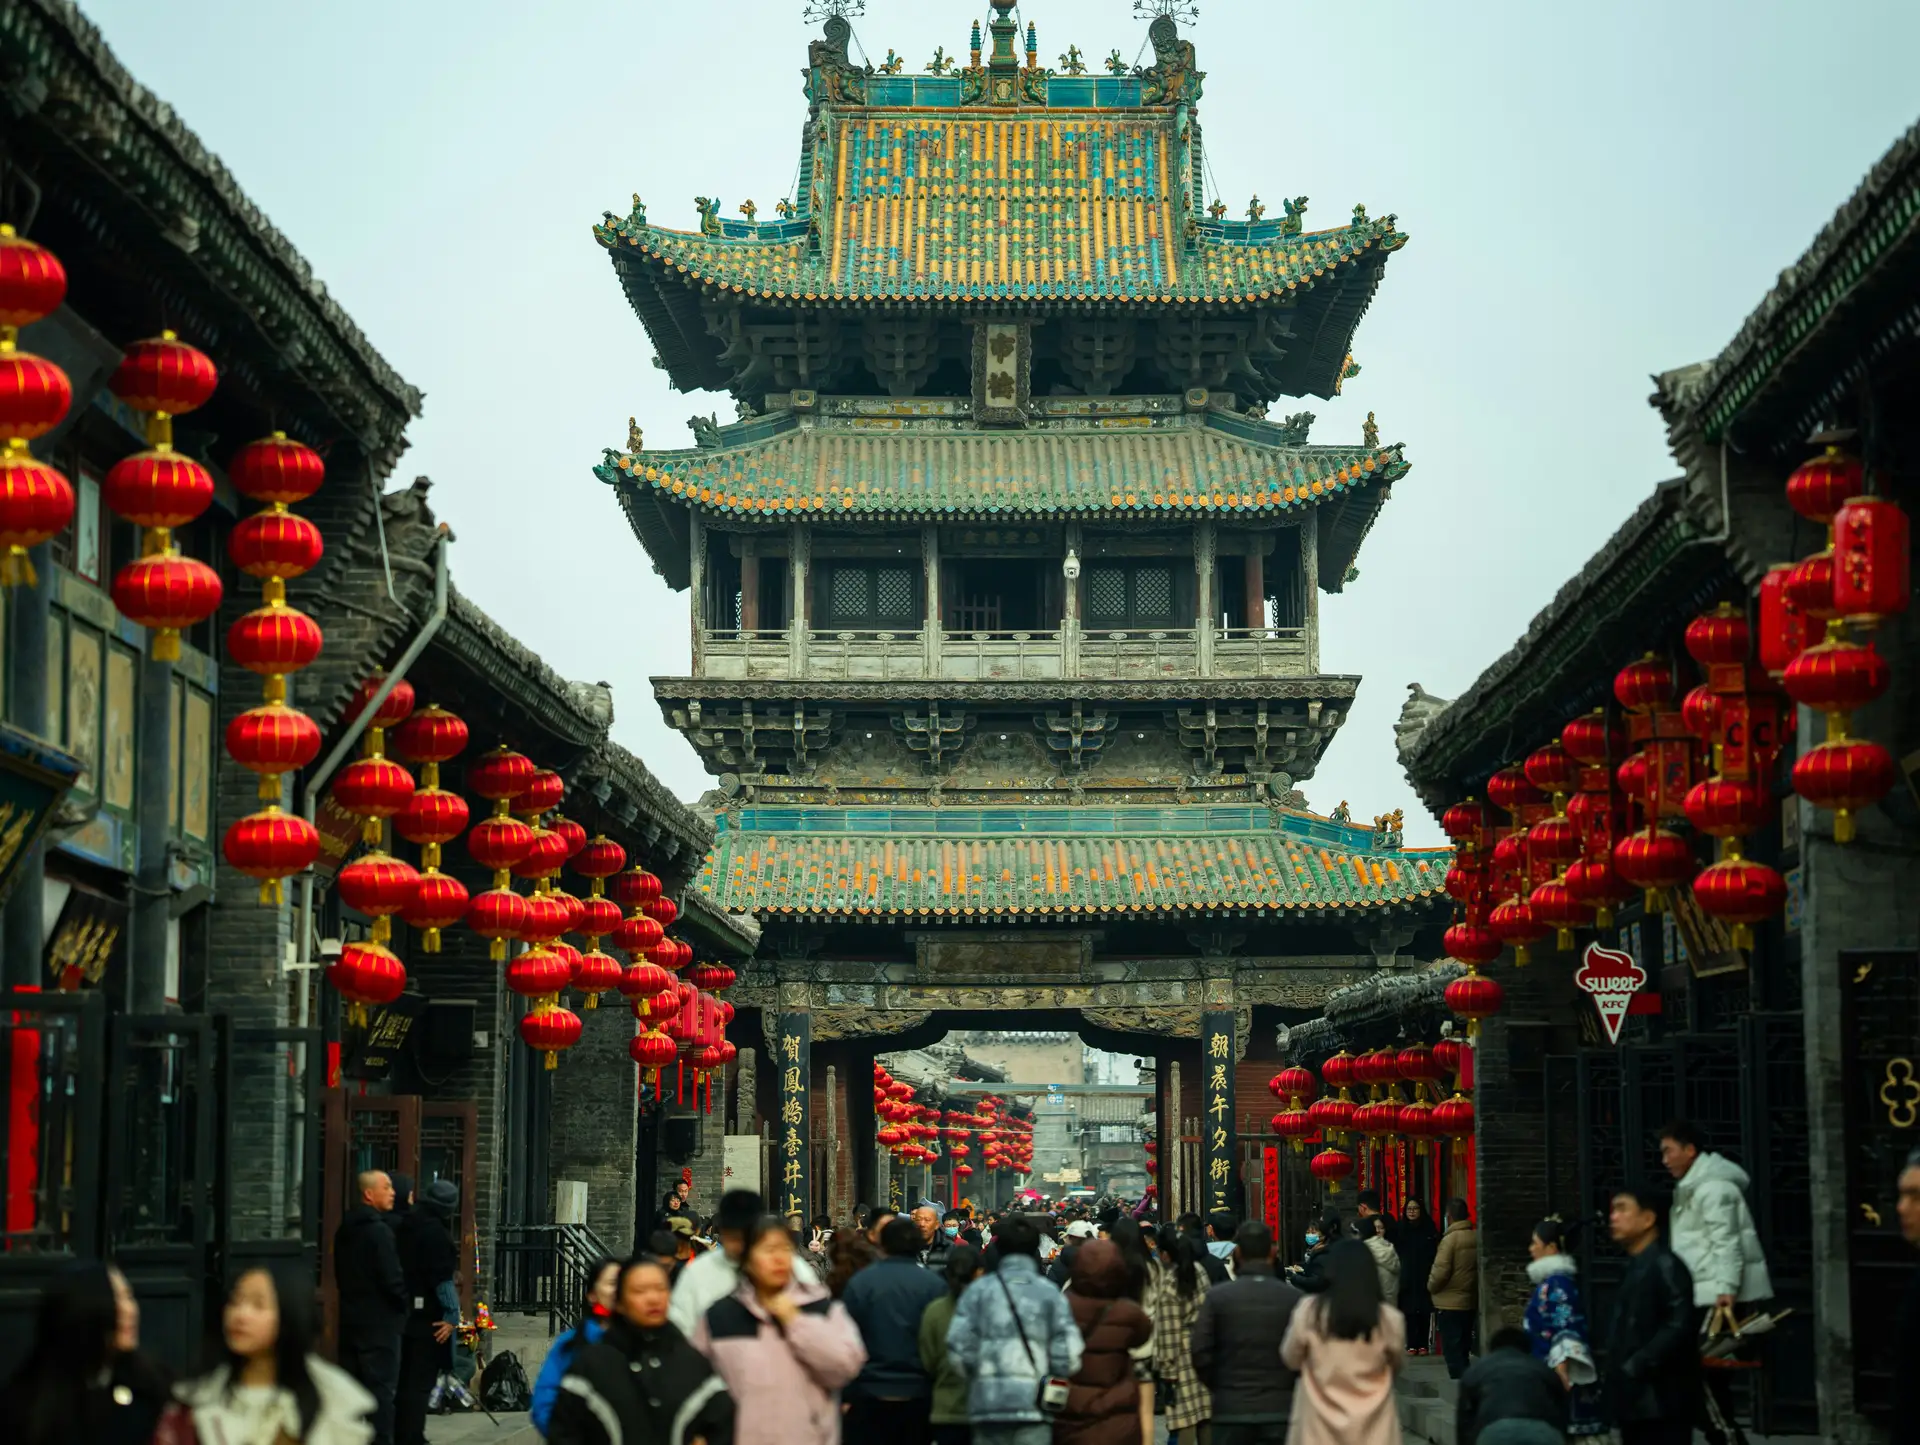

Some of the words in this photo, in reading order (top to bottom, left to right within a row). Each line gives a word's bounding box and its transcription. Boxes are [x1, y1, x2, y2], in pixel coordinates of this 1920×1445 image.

[1601, 1000, 1625, 1009] KFC
[1207, 1032, 1231, 1214] 朝晨午夕街三
